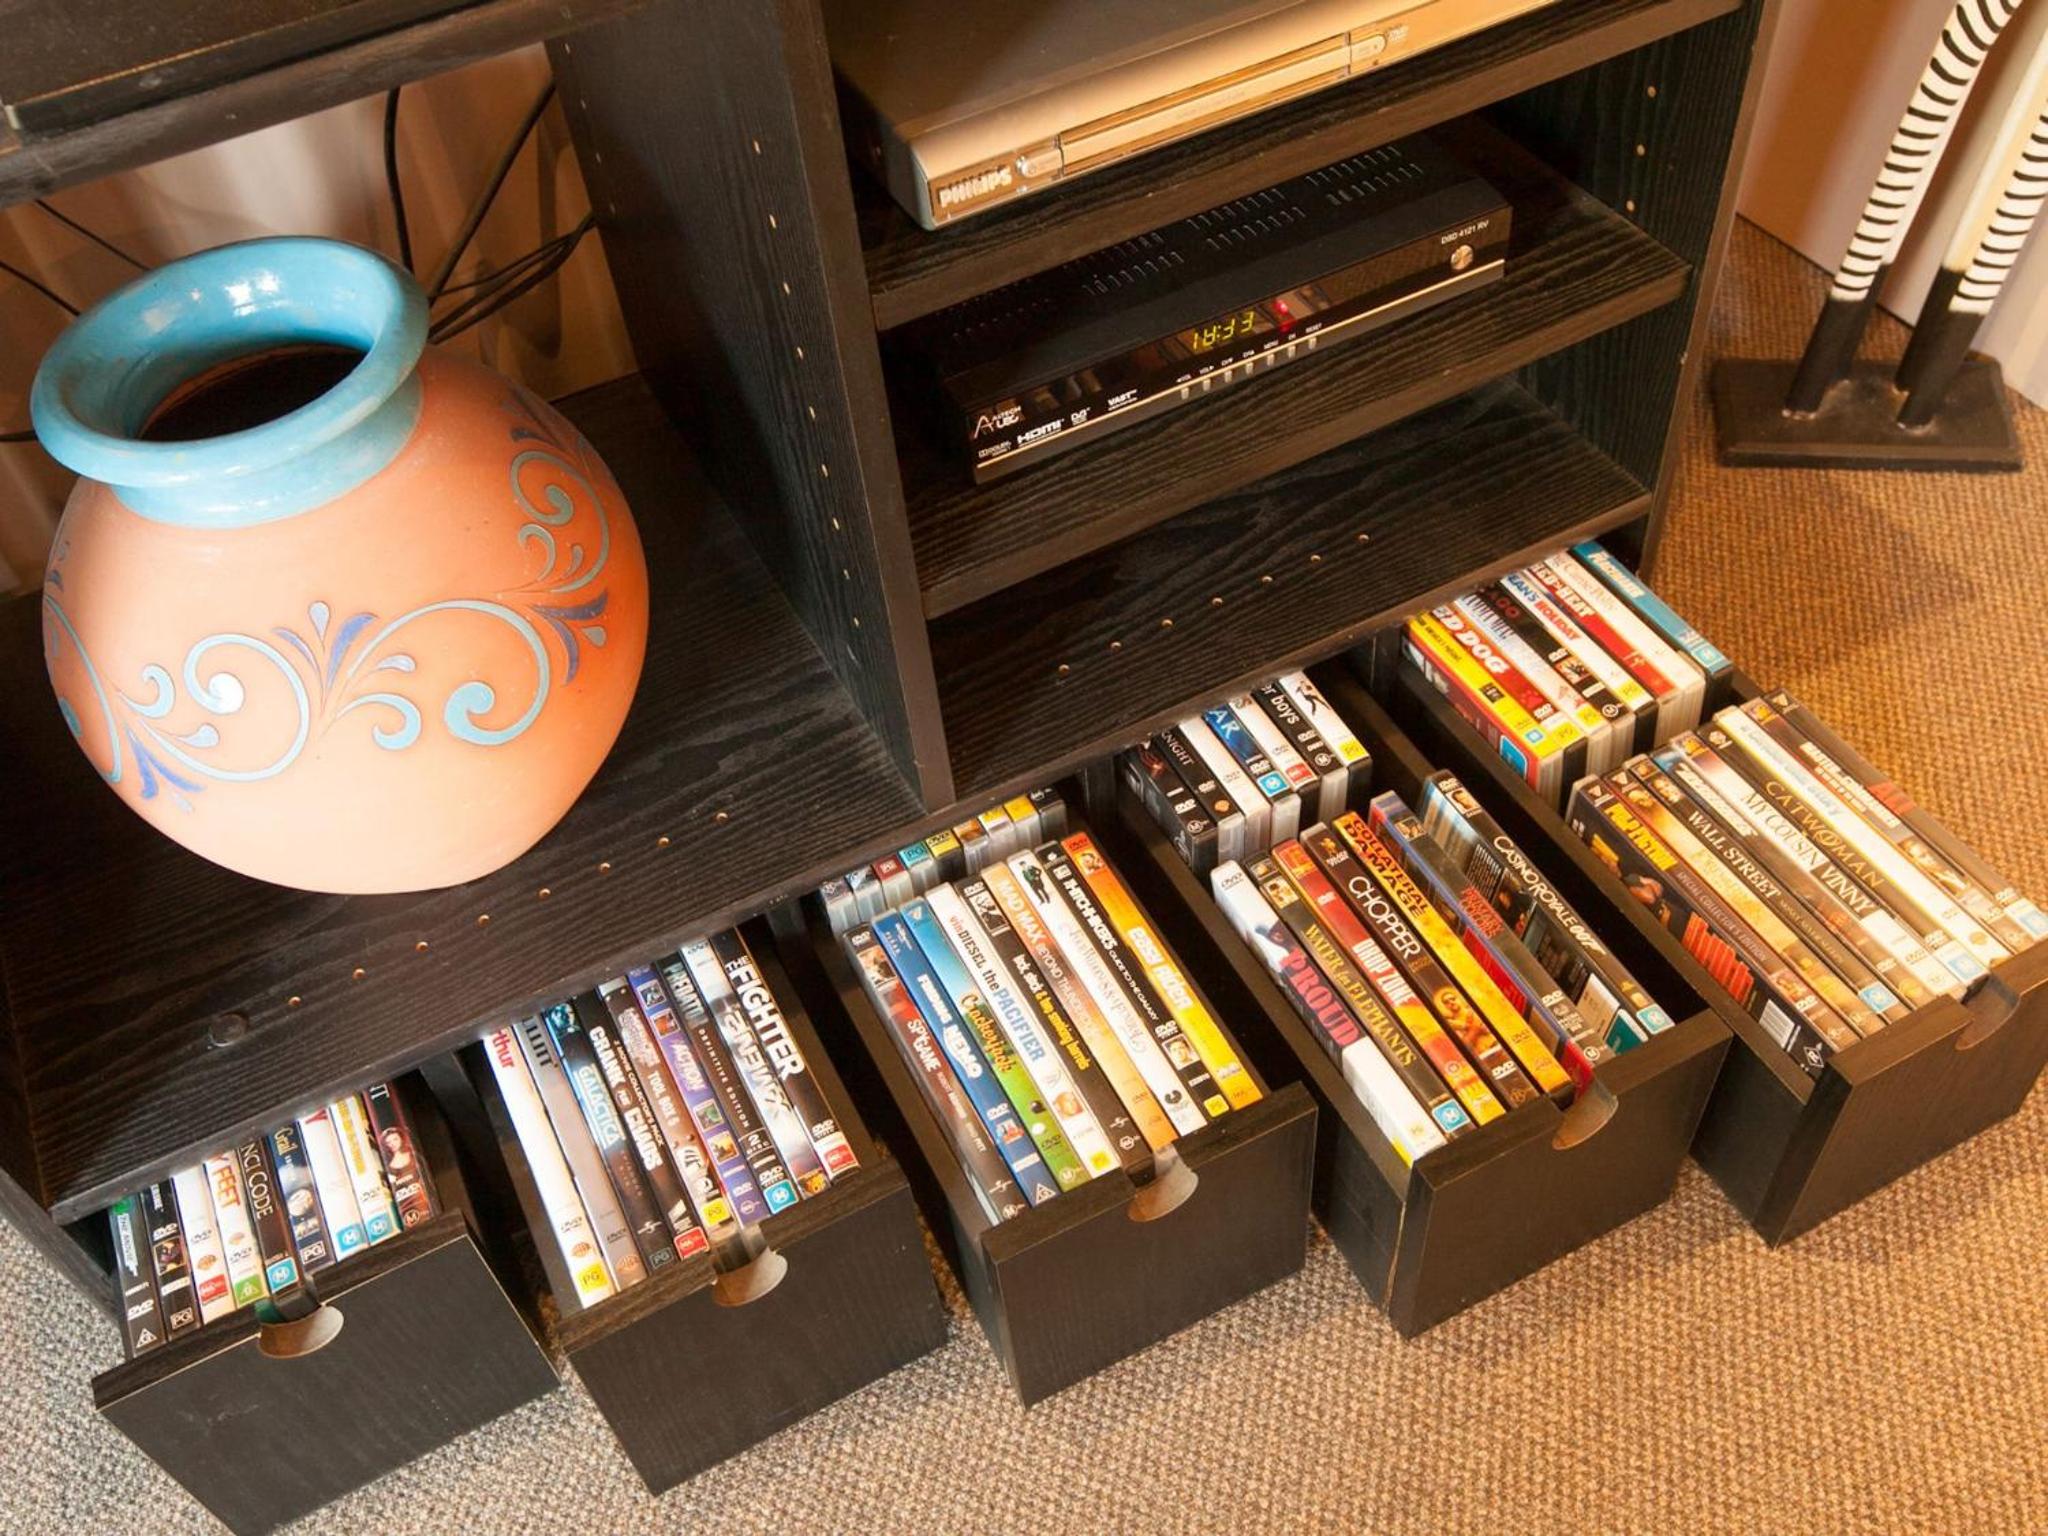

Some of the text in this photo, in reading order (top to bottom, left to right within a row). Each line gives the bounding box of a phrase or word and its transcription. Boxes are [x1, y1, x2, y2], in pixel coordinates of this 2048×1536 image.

[936, 165, 1015, 207] PHILIPS
[1457, 225, 1476, 237] 4121
[1016, 419, 1062, 444] HDMI
[1533, 597, 1581, 644] HOLIDAY
[1555, 584, 1595, 621] HEAT
[1455, 625, 1510, 677] DOG
[1207, 703, 1241, 739] AR
[1268, 692, 1302, 726] boys
[1686, 809, 1728, 850] WALL
[1722, 844, 1780, 903] STREET
[1762, 777, 1885, 891] CATWOMAN
[1342, 821, 1423, 920] DAMAGE
[1352, 816, 1431, 914] COLLATERAL
[1490, 832, 1541, 887] CASINO
[1529, 877, 1578, 929] ROYALE
[1604, 800, 1640, 835] PULP
[1630, 826, 1677, 874] FICTION
[1675, 870, 1702, 897] SPECIAL
[1699, 893, 1742, 937] COLLECTOR'S
[1738, 934, 1767, 963] EDITION
[1764, 810, 1824, 870] COUSIN
[1818, 862, 1874, 918] VINNY
[995, 877, 1062, 979] MAD MAX BEYOND
[1345, 871, 1421, 961] CHOPPER
[725, 954, 750, 973] THE
[957, 927, 990, 968] DIESEL
[980, 968, 1003, 992] the
[1301, 923, 1345, 972] WATER
[1345, 979, 1419, 1068] ELEPHANTS
[1351, 935, 1416, 1009] DROP ZONE
[728, 961, 807, 1081] FIGHTER
[1275, 946, 1364, 1050] PROUD
[905, 1016, 928, 1042] SPY
[991, 986, 1047, 1062] PACIFIER
[669, 1038, 707, 1091] ACTION
[911, 1036, 941, 1073] GAME
[942, 1021, 985, 1081] NEMO
[1492, 1061, 1515, 1077] DVD
[586, 1025, 625, 1087] CRANK
[621, 1106, 662, 1171] CHAOS
[645, 1070, 667, 1097] TOOL
[656, 1095, 676, 1118] BOX
[696, 1028, 729, 1084] DEFINITIVE
[724, 1086, 750, 1128] EDITION
[574, 1065, 621, 1145] GALACTICA
[810, 1118, 834, 1133] DVD
[271, 1125, 298, 1156] Grail
[746, 1132, 761, 1146] 2
[211, 1164, 242, 1211] FEET
[245, 1171, 277, 1219] CODE
[394, 1183, 422, 1201] DVD
[757, 1164, 783, 1182] DVD
[301, 1242, 325, 1262] PG
[127, 1298, 155, 1318] DVD
[171, 1310, 193, 1327] PG
